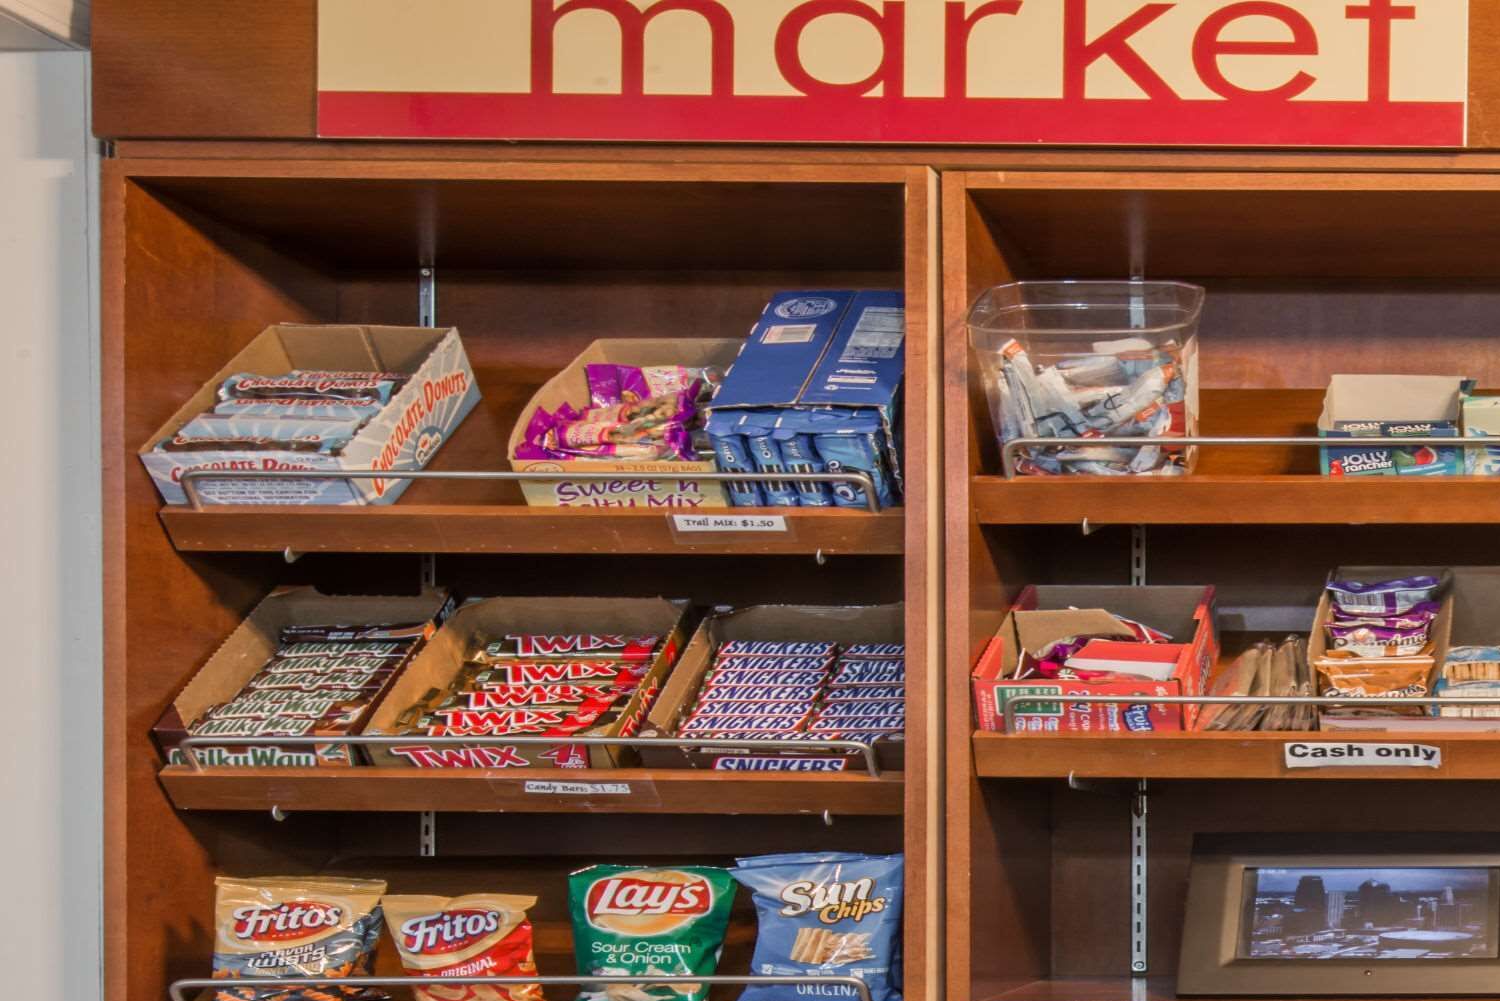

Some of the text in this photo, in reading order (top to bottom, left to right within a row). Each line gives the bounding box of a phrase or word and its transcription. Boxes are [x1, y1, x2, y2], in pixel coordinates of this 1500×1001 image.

[529, 0, 1416, 102] market
[422, 372, 468, 414] DONUTS
[1341, 451, 1389, 467] JOLLY
[1344, 461, 1393, 473] rancher
[556, 480, 664, 502] Sweet
[683, 517, 710, 527] Trail
[740, 519, 775, 528] $1.50
[506, 635, 626, 656] TWIX
[724, 641, 834, 655] SNICKERS
[495, 662, 622, 684] TWIX
[720, 656, 829, 670] SNICKERS
[714, 671, 823, 685] SNICKERS
[707, 686, 817, 701] SNICKERS
[701, 701, 811, 715] SNICKERS
[435, 709, 569, 729] TWIX
[687, 715, 799, 730] SNICKERS
[390, 745, 530, 768] TWIX
[1287, 742, 1437, 762] Cash only
[716, 758, 845, 771] SNICKERS
[594, 877, 705, 917] Lay's
[778, 876, 875, 918] Sun
[819, 895, 886, 924] Chips
[233, 902, 343, 940] Fritos
[400, 910, 502, 954] Fritos
[591, 940, 692, 955] Sour Cream
[605, 952, 673, 965] & Onion
